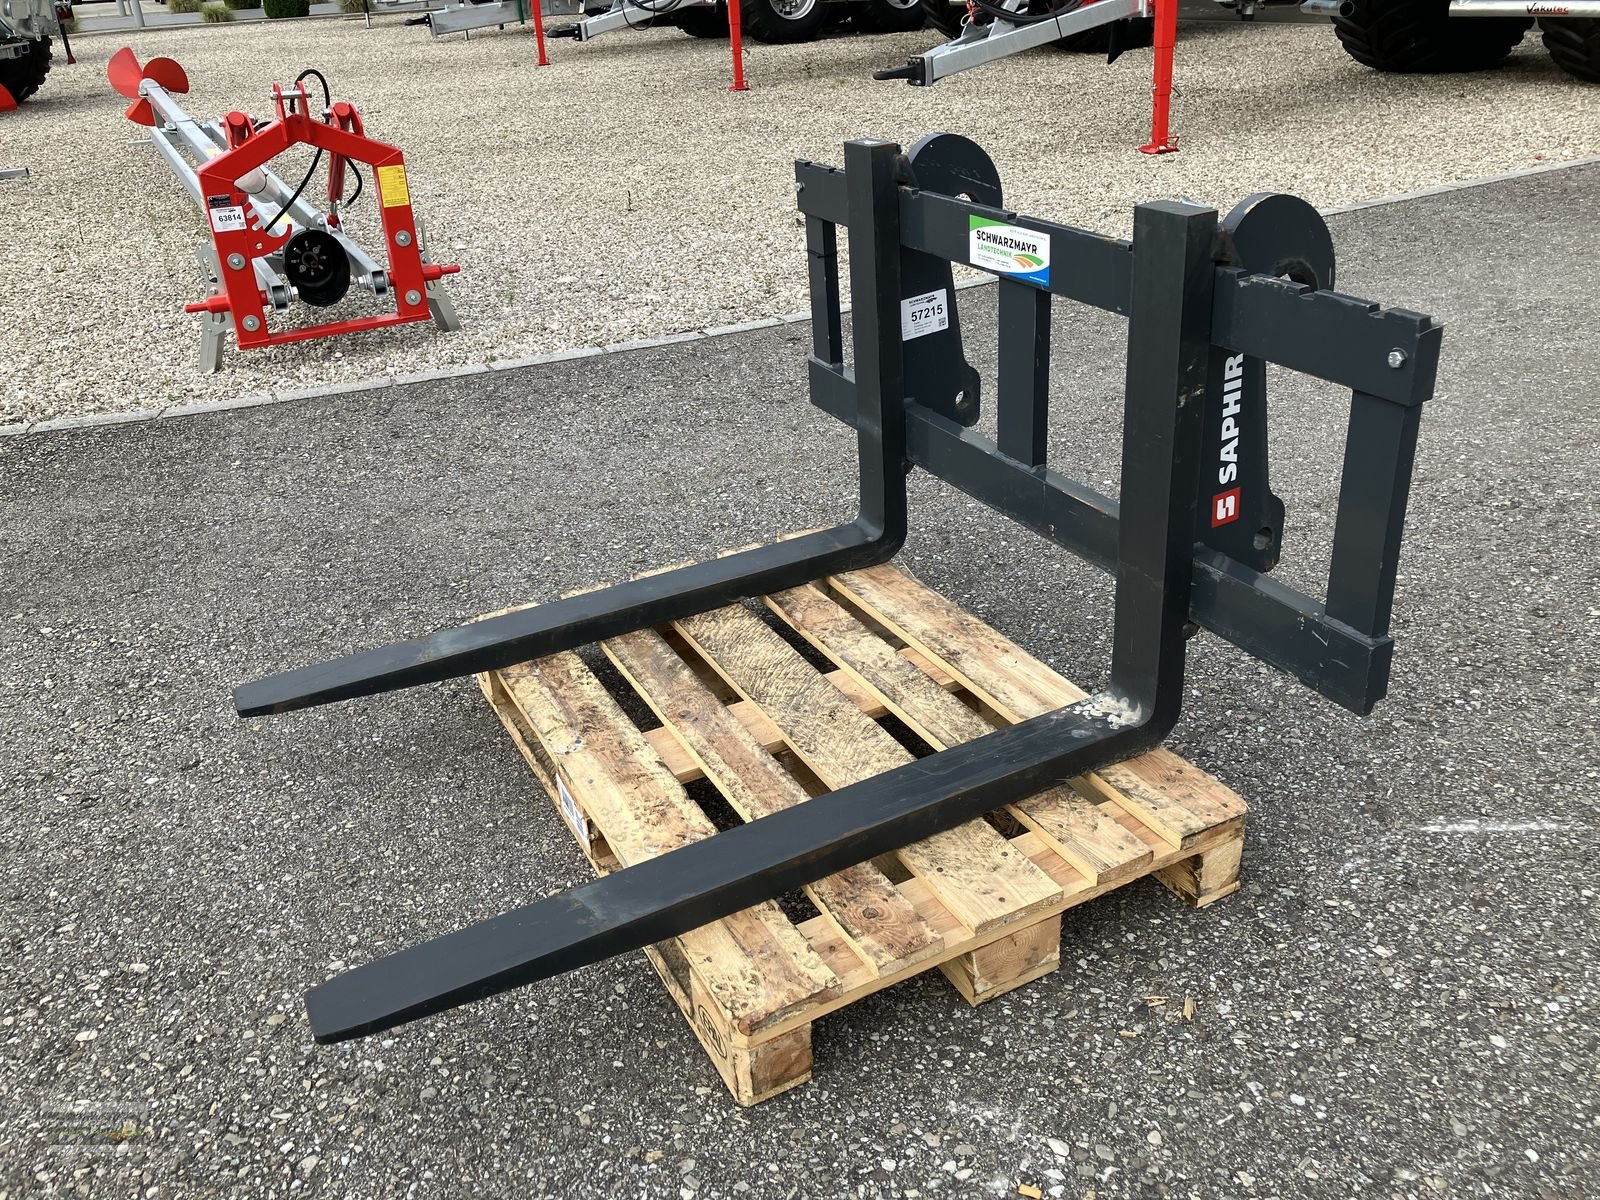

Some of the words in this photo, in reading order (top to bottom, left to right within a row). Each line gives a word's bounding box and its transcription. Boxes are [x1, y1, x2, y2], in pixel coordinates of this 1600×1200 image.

[1526, 2, 1568, 14] Vakutec
[218, 214, 242, 222] 63814
[976, 229, 1038, 254] SCHWARZMAYR
[977, 243, 1012, 258] LANDTECHNIK
[911, 303, 943, 322] 57215
[1218, 353, 1244, 485] SAPHIR
